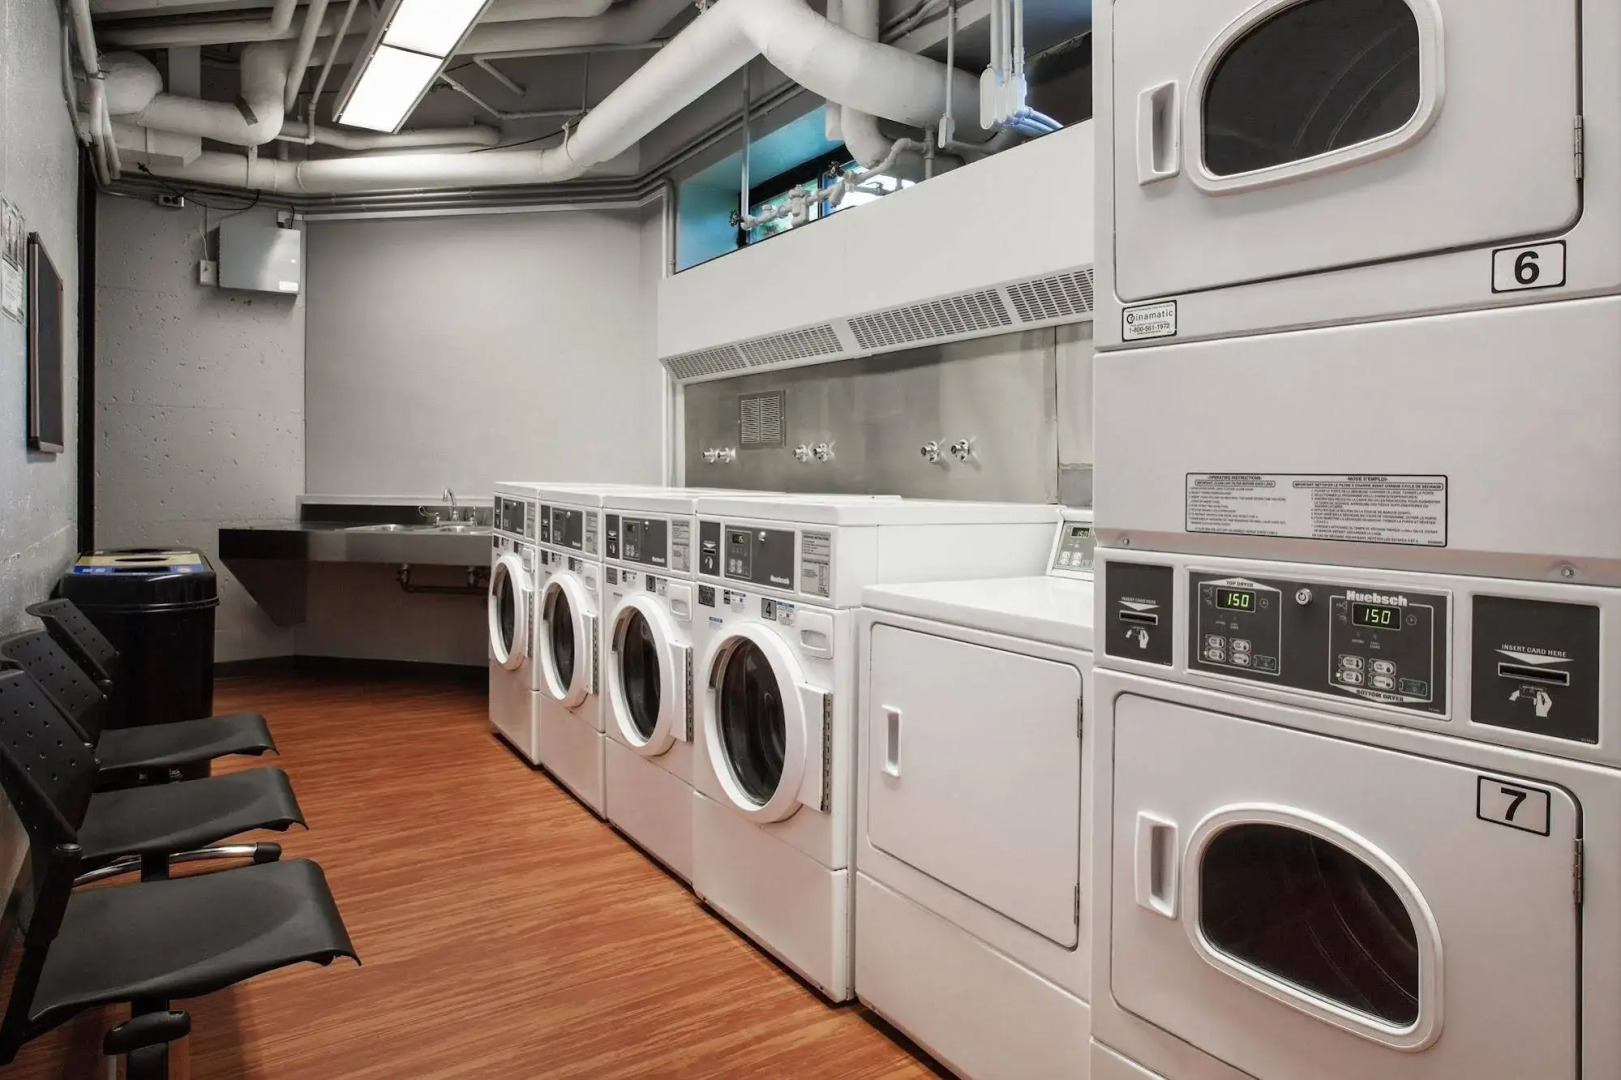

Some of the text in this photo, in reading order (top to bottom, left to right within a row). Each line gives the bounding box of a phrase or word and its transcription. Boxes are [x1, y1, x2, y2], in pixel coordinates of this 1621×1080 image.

[1514, 251, 1540, 285] 6
[1227, 593, 1250, 608] 150
[1346, 590, 1408, 607] Huebsch
[765, 601, 772, 617] 4
[1365, 608, 1391, 625] 150
[1501, 643, 1567, 658] INSERT CARD HERE
[1356, 689, 1405, 702] BOTTOM DRYER
[1500, 786, 1527, 822] 7
